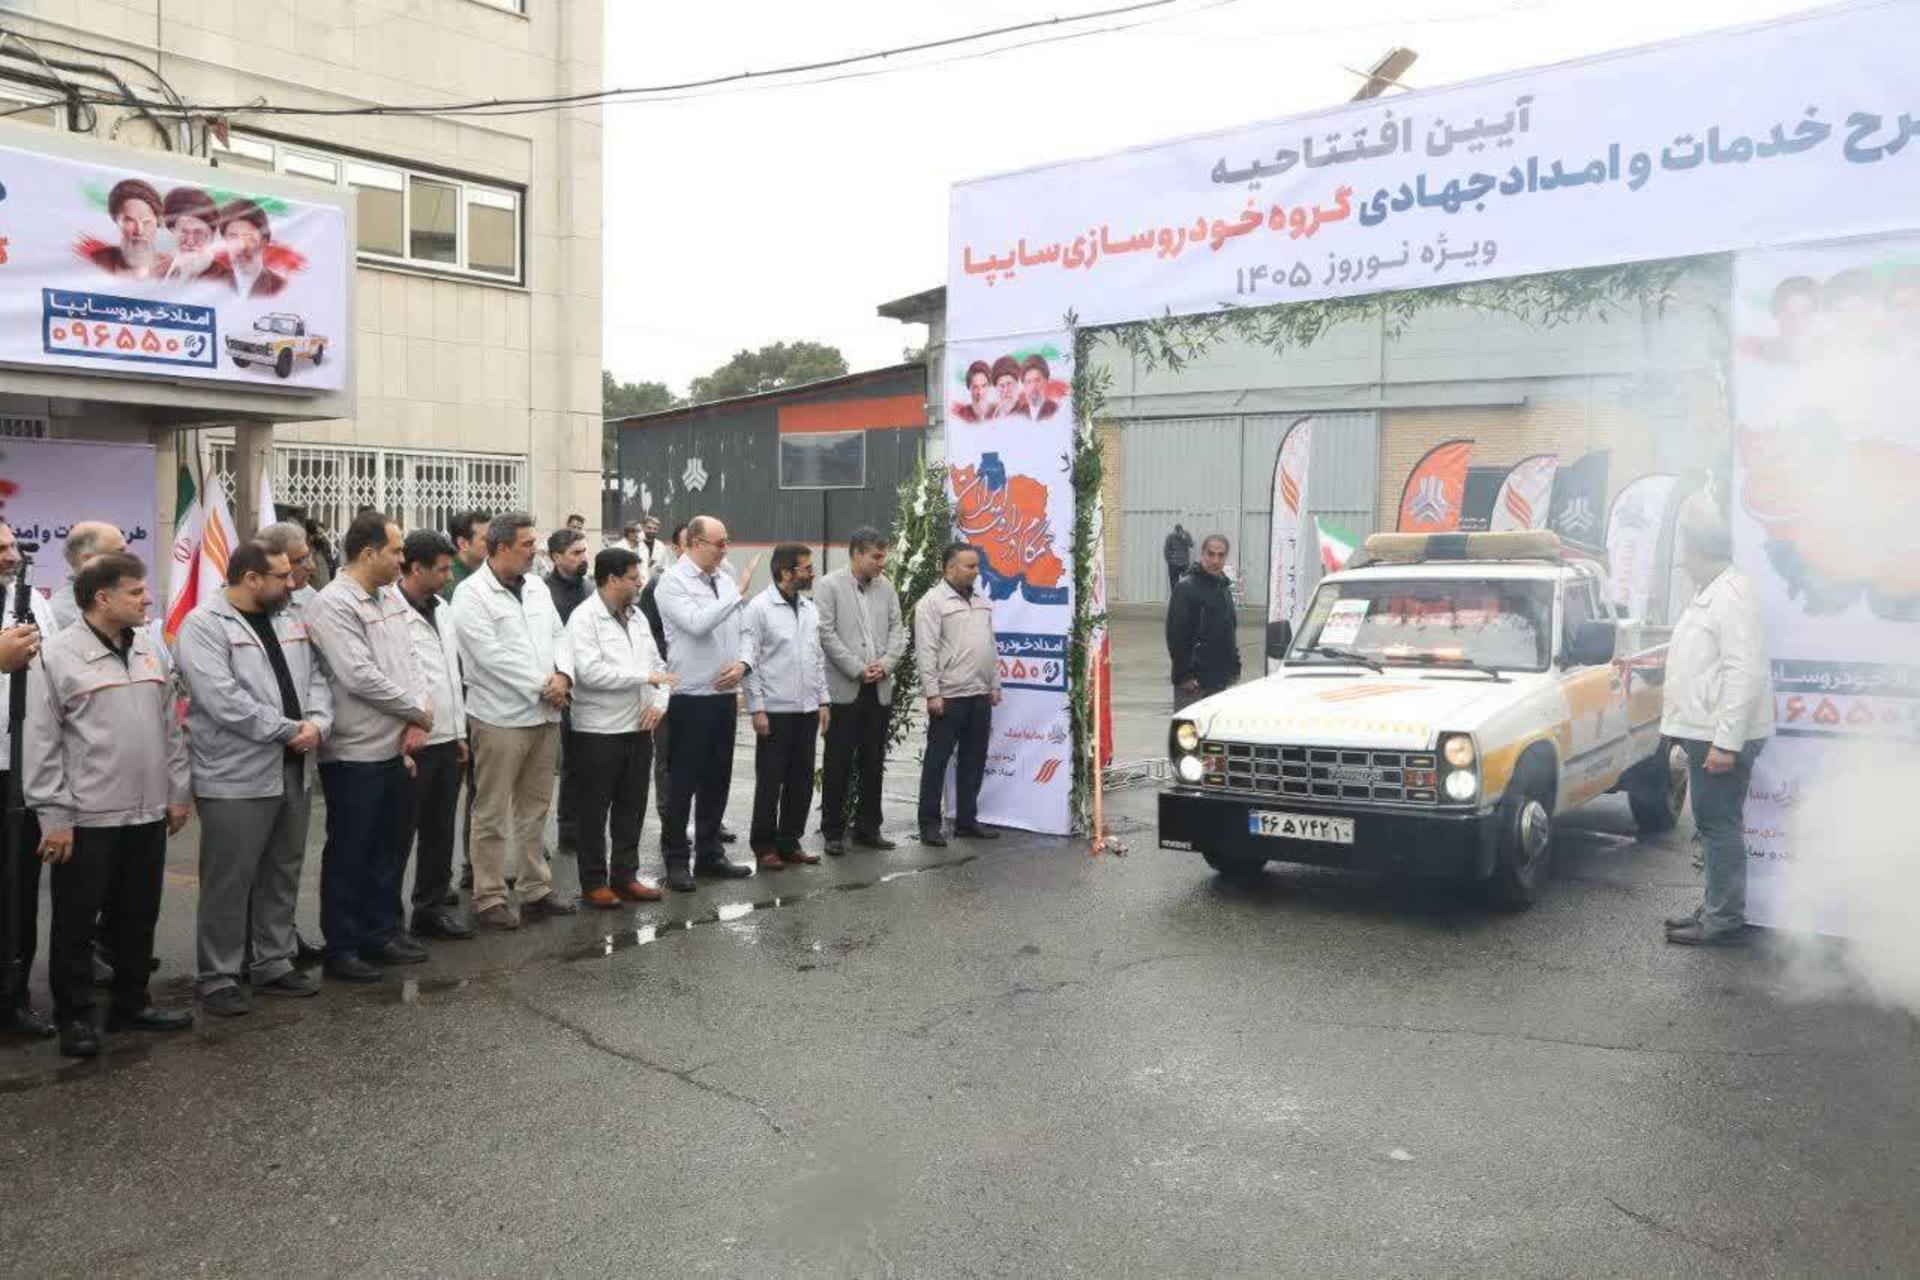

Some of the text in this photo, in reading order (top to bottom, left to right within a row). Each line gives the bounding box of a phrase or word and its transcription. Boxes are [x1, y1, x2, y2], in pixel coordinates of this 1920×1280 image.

[1211, 95, 1534, 190] آیین افتتاحیه
[1660, 104, 1832, 171] خدمات
[1844, 109, 1920, 164] رح
[1499, 143, 1621, 196] امداد
[1627, 151, 1652, 192] و
[1268, 185, 1353, 240] گروه
[1359, 172, 1496, 227] جهادی
[964, 238, 1060, 287] سایپا
[1236, 232, 1498, 294] ویژه نوروز ۱۴۰۵
[49, 292, 119, 317] سایپا
[52, 321, 179, 353] ۰۹۶۵۵۰
[120, 525, 147, 544] طر
[1000, 659, 1039, 679] ۵۵۰
